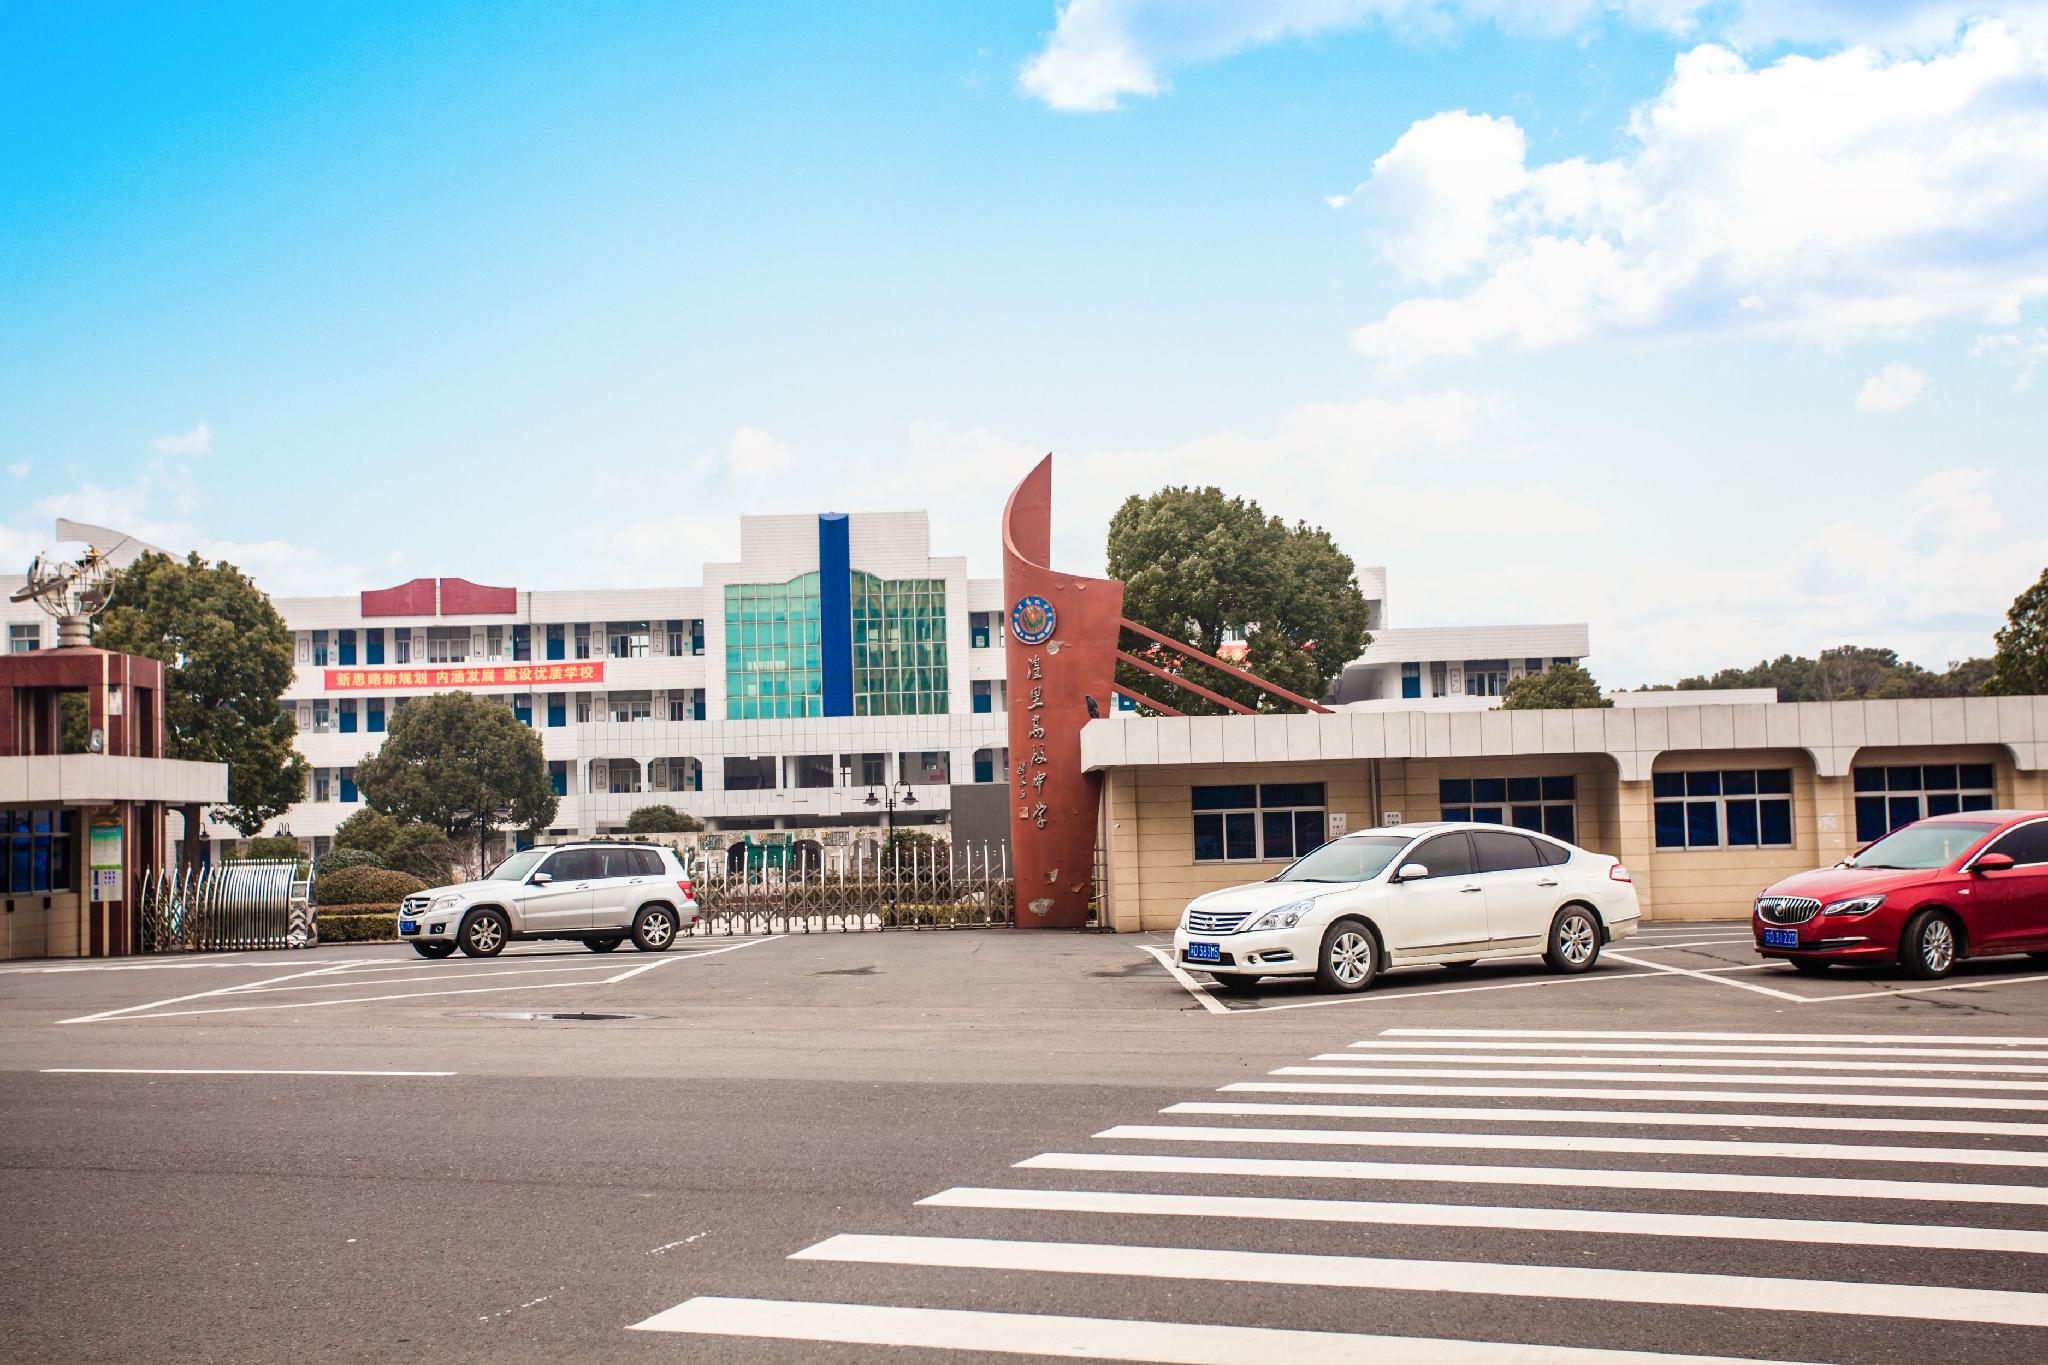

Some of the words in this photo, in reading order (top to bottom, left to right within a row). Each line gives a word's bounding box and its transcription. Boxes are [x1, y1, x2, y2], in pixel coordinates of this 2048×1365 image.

[336, 671, 428, 687] 新思路新规划
[436, 669, 496, 684] 内涵发展
[504, 666, 594, 682] 建设优质学校
